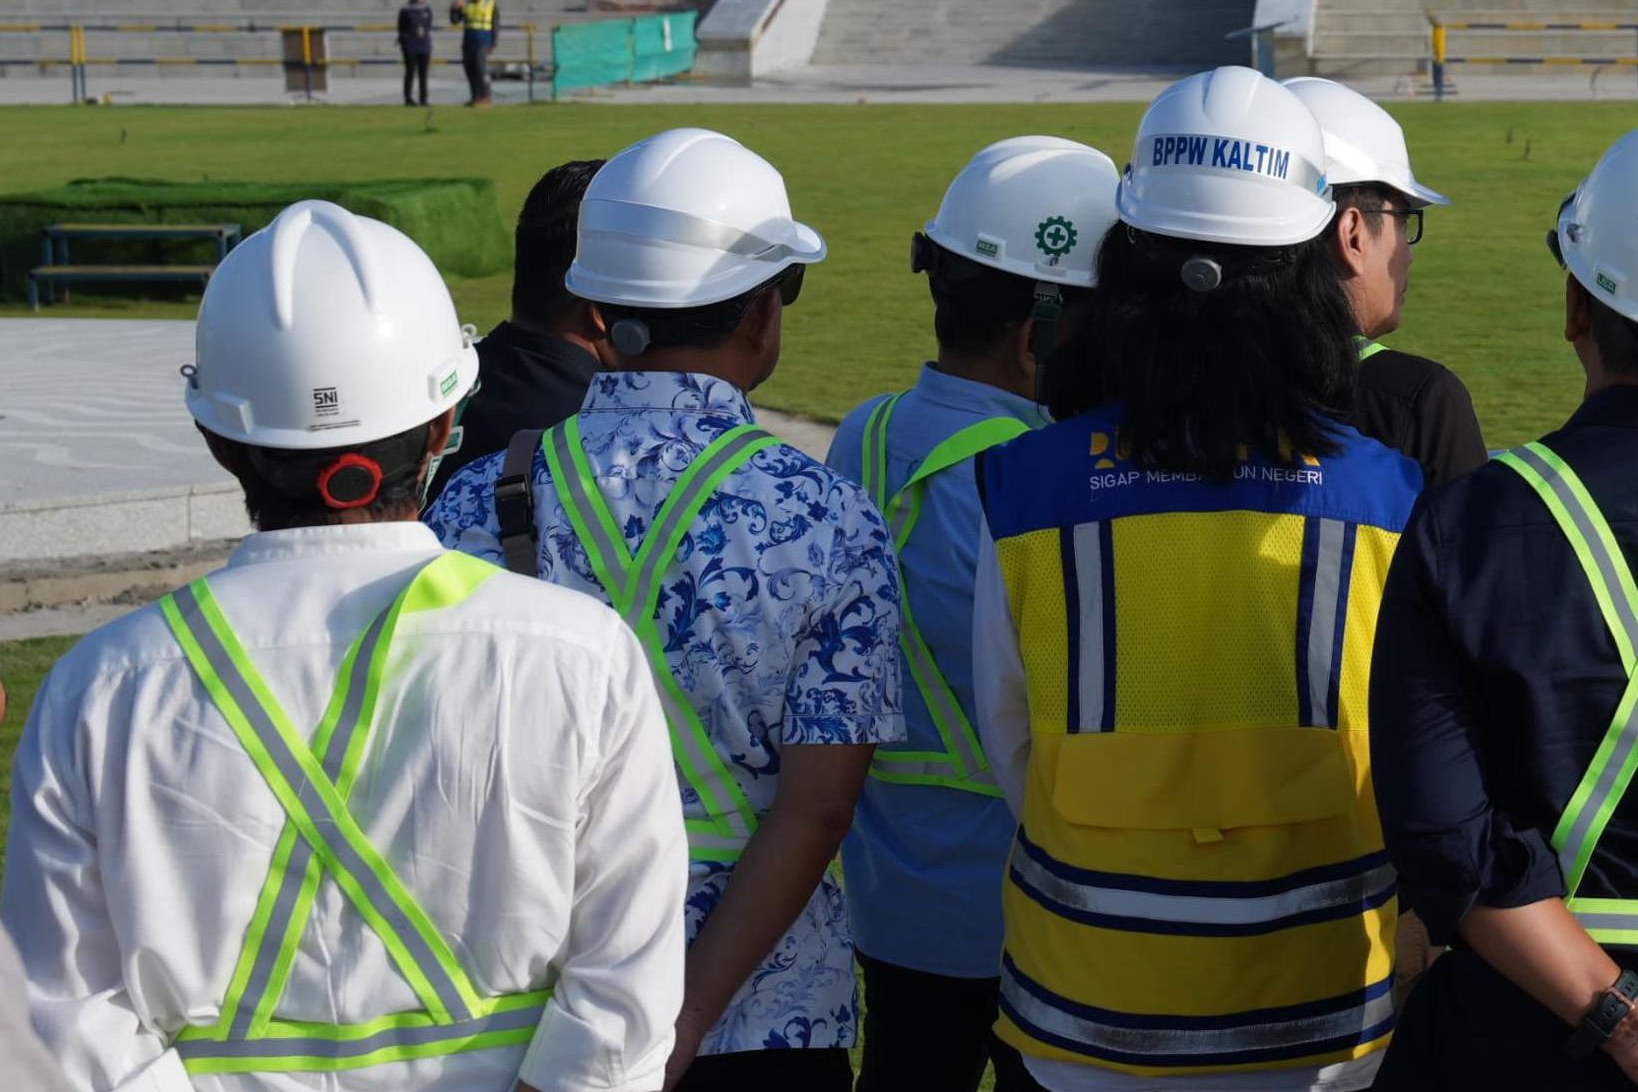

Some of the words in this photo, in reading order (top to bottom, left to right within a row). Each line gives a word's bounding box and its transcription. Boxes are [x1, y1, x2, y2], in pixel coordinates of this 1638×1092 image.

[1153, 137, 1207, 166] BPPW
[1212, 139, 1290, 179] KALTIM
[313, 391, 338, 405] SNI
[1090, 471, 1140, 489] SIGAP
[1147, 465, 1256, 483] MEMBUN
[1262, 467, 1323, 485] NEGERI
